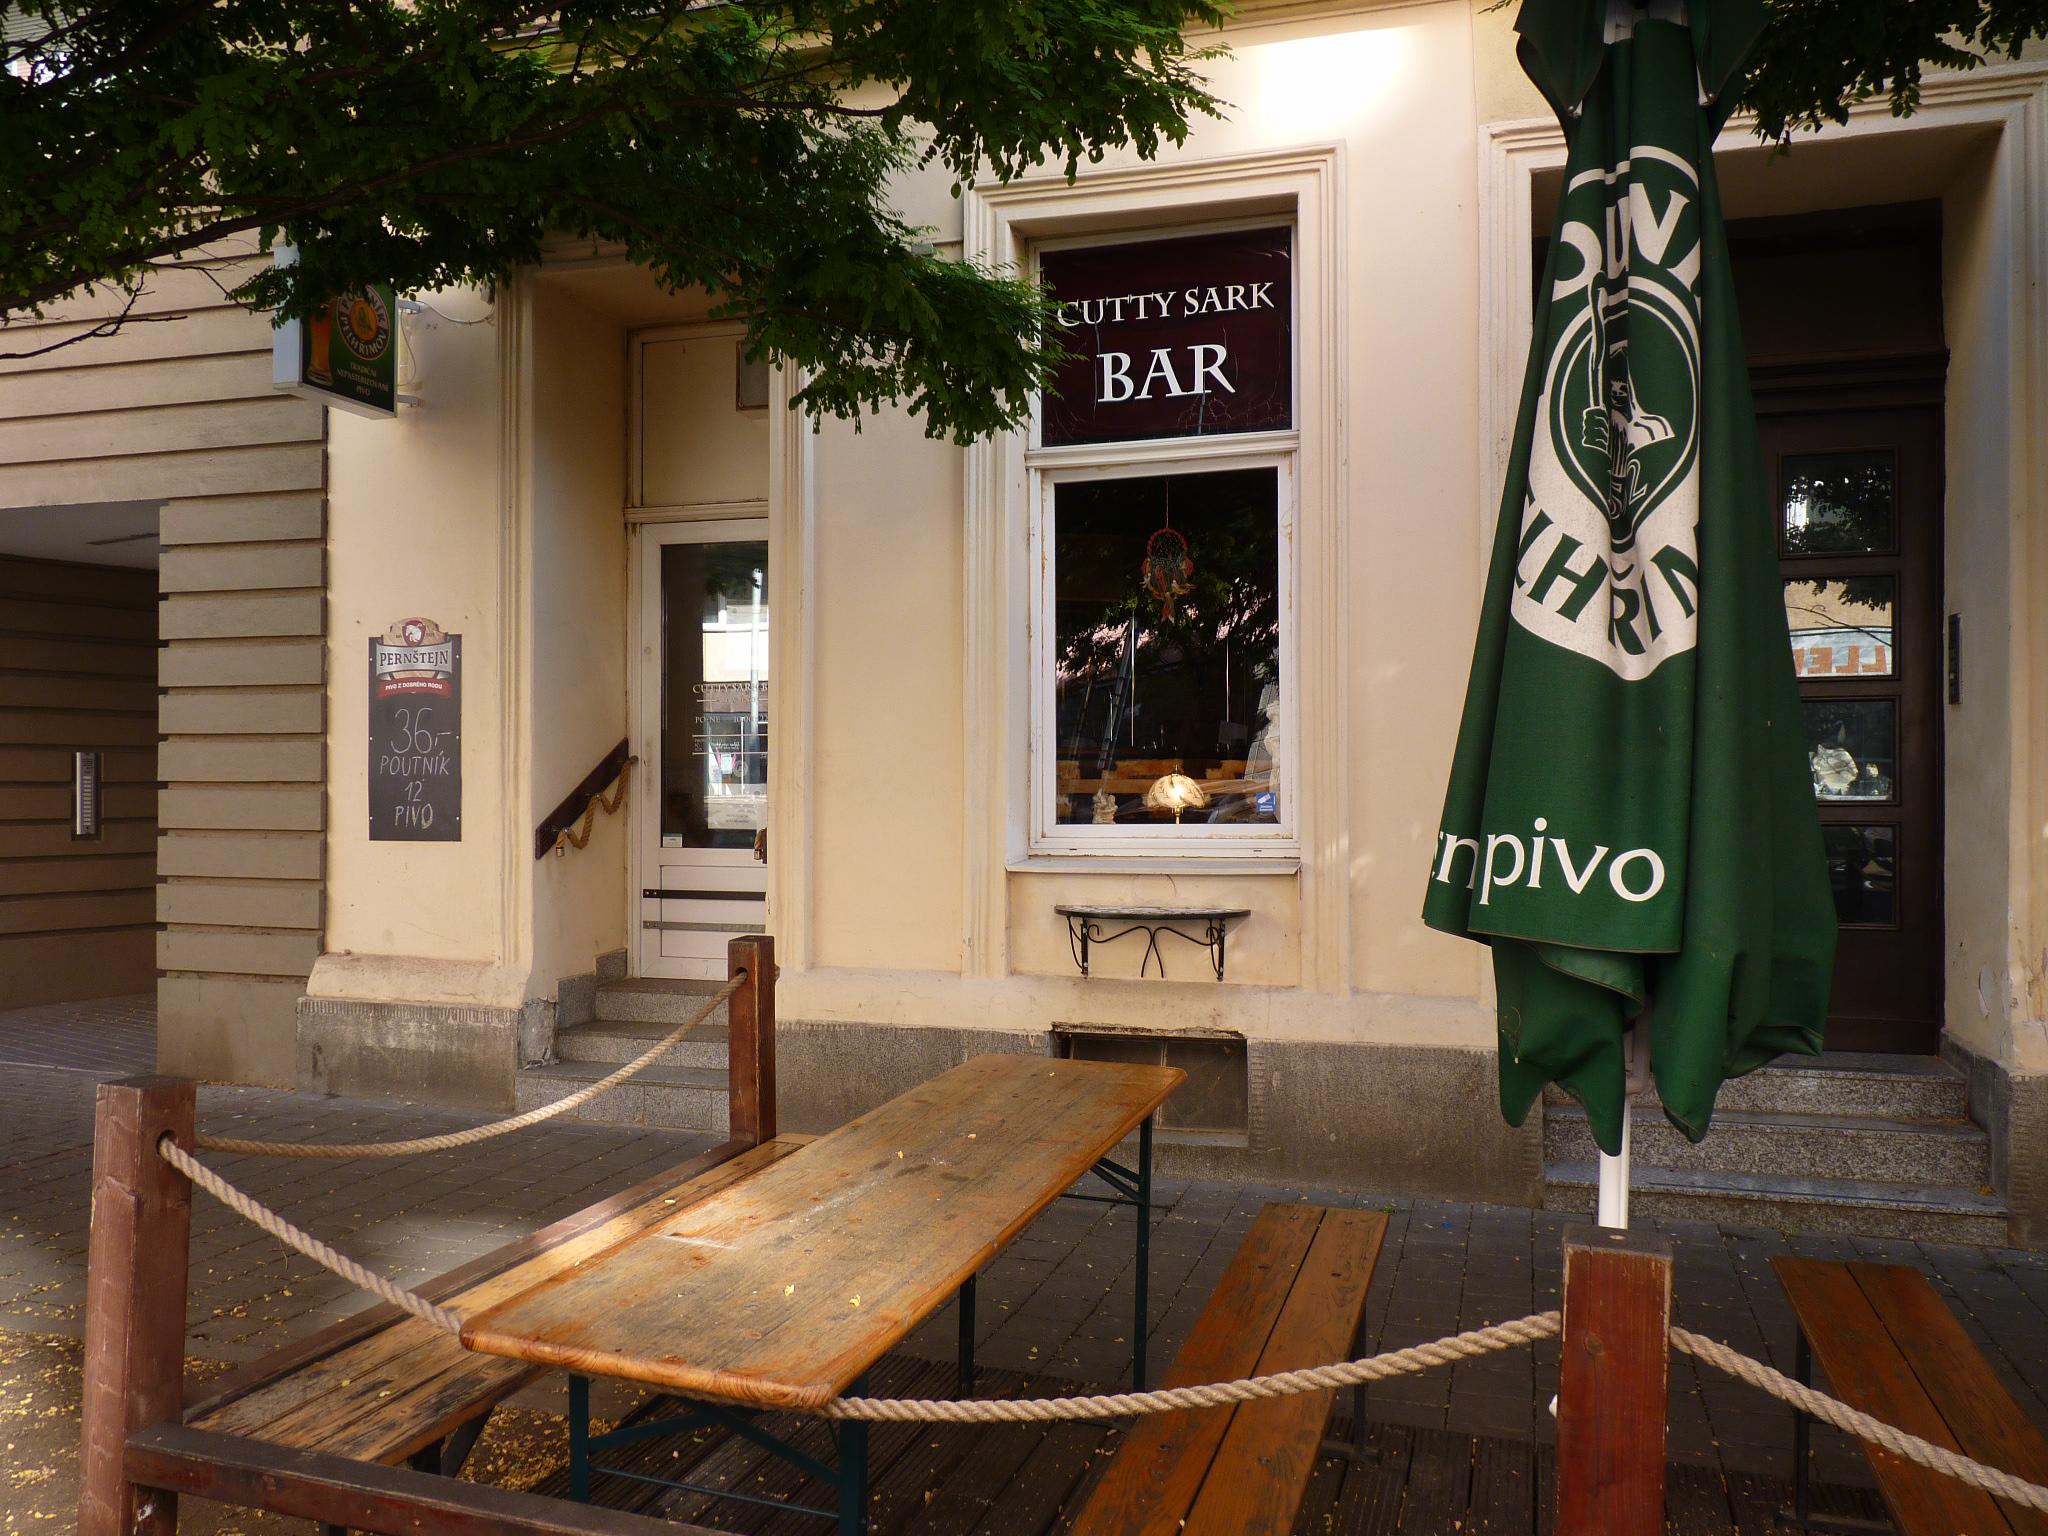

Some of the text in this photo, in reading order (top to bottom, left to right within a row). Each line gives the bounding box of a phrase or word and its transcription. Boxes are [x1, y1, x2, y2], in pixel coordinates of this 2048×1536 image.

[1056, 282, 1275, 328] CUTTY SARK
[1096, 344, 1236, 403] BAR
[379, 650, 449, 667] PERNŠTEJN
[379, 750, 451, 776] POUTNÍK
[394, 803, 434, 830] PIVO
